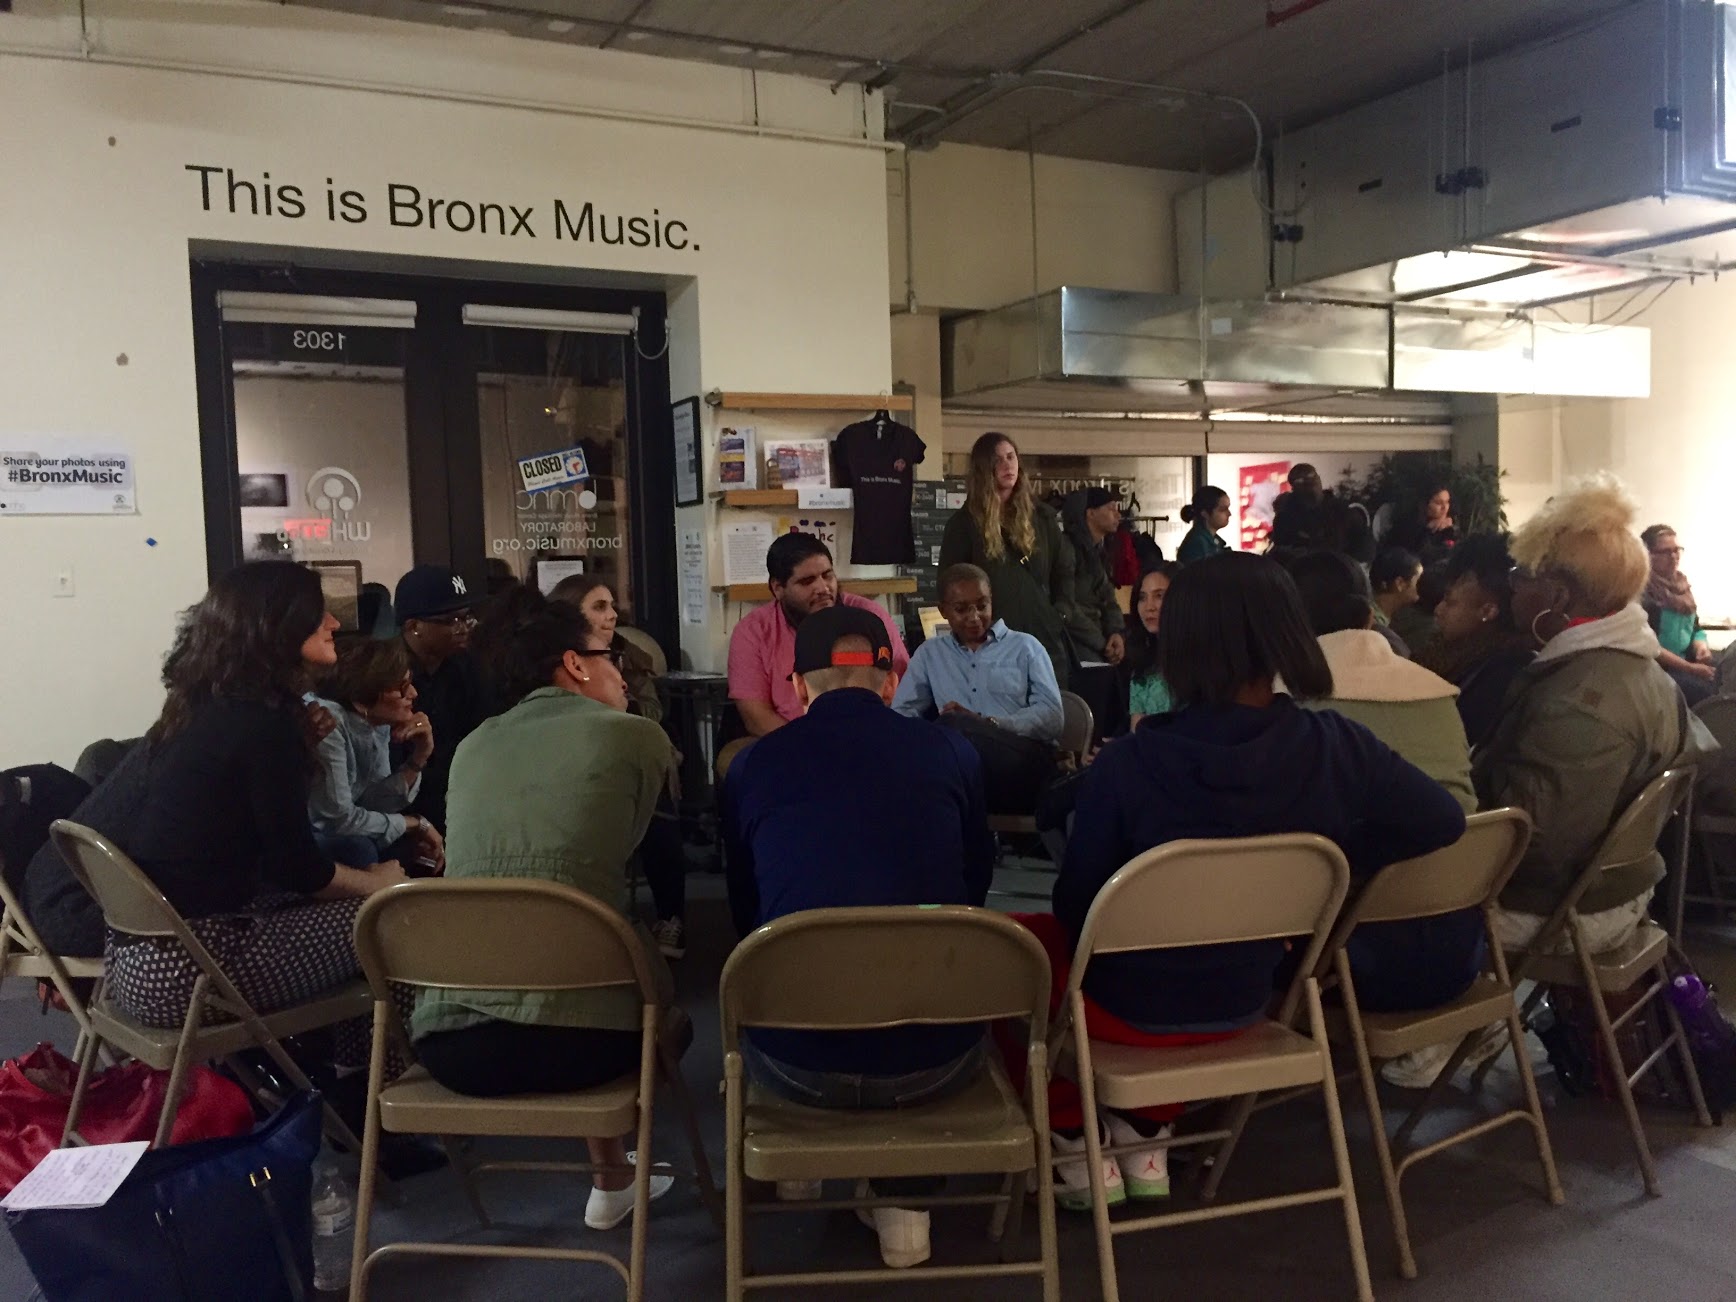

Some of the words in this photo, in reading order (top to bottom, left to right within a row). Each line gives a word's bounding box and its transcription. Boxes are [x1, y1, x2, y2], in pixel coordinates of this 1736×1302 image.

[185, 164, 306, 219] This
[327, 176, 368, 223] is
[388, 183, 536, 238] Bronx
[555, 199, 701, 251] Music.
[3, 456, 33, 466] Share
[36, 459, 58, 468] your
[62, 458, 95, 468] photos
[99, 458, 126, 469] using
[523, 455, 562, 479] CLOSED
[8, 468, 123, 483] #BronxMusic
